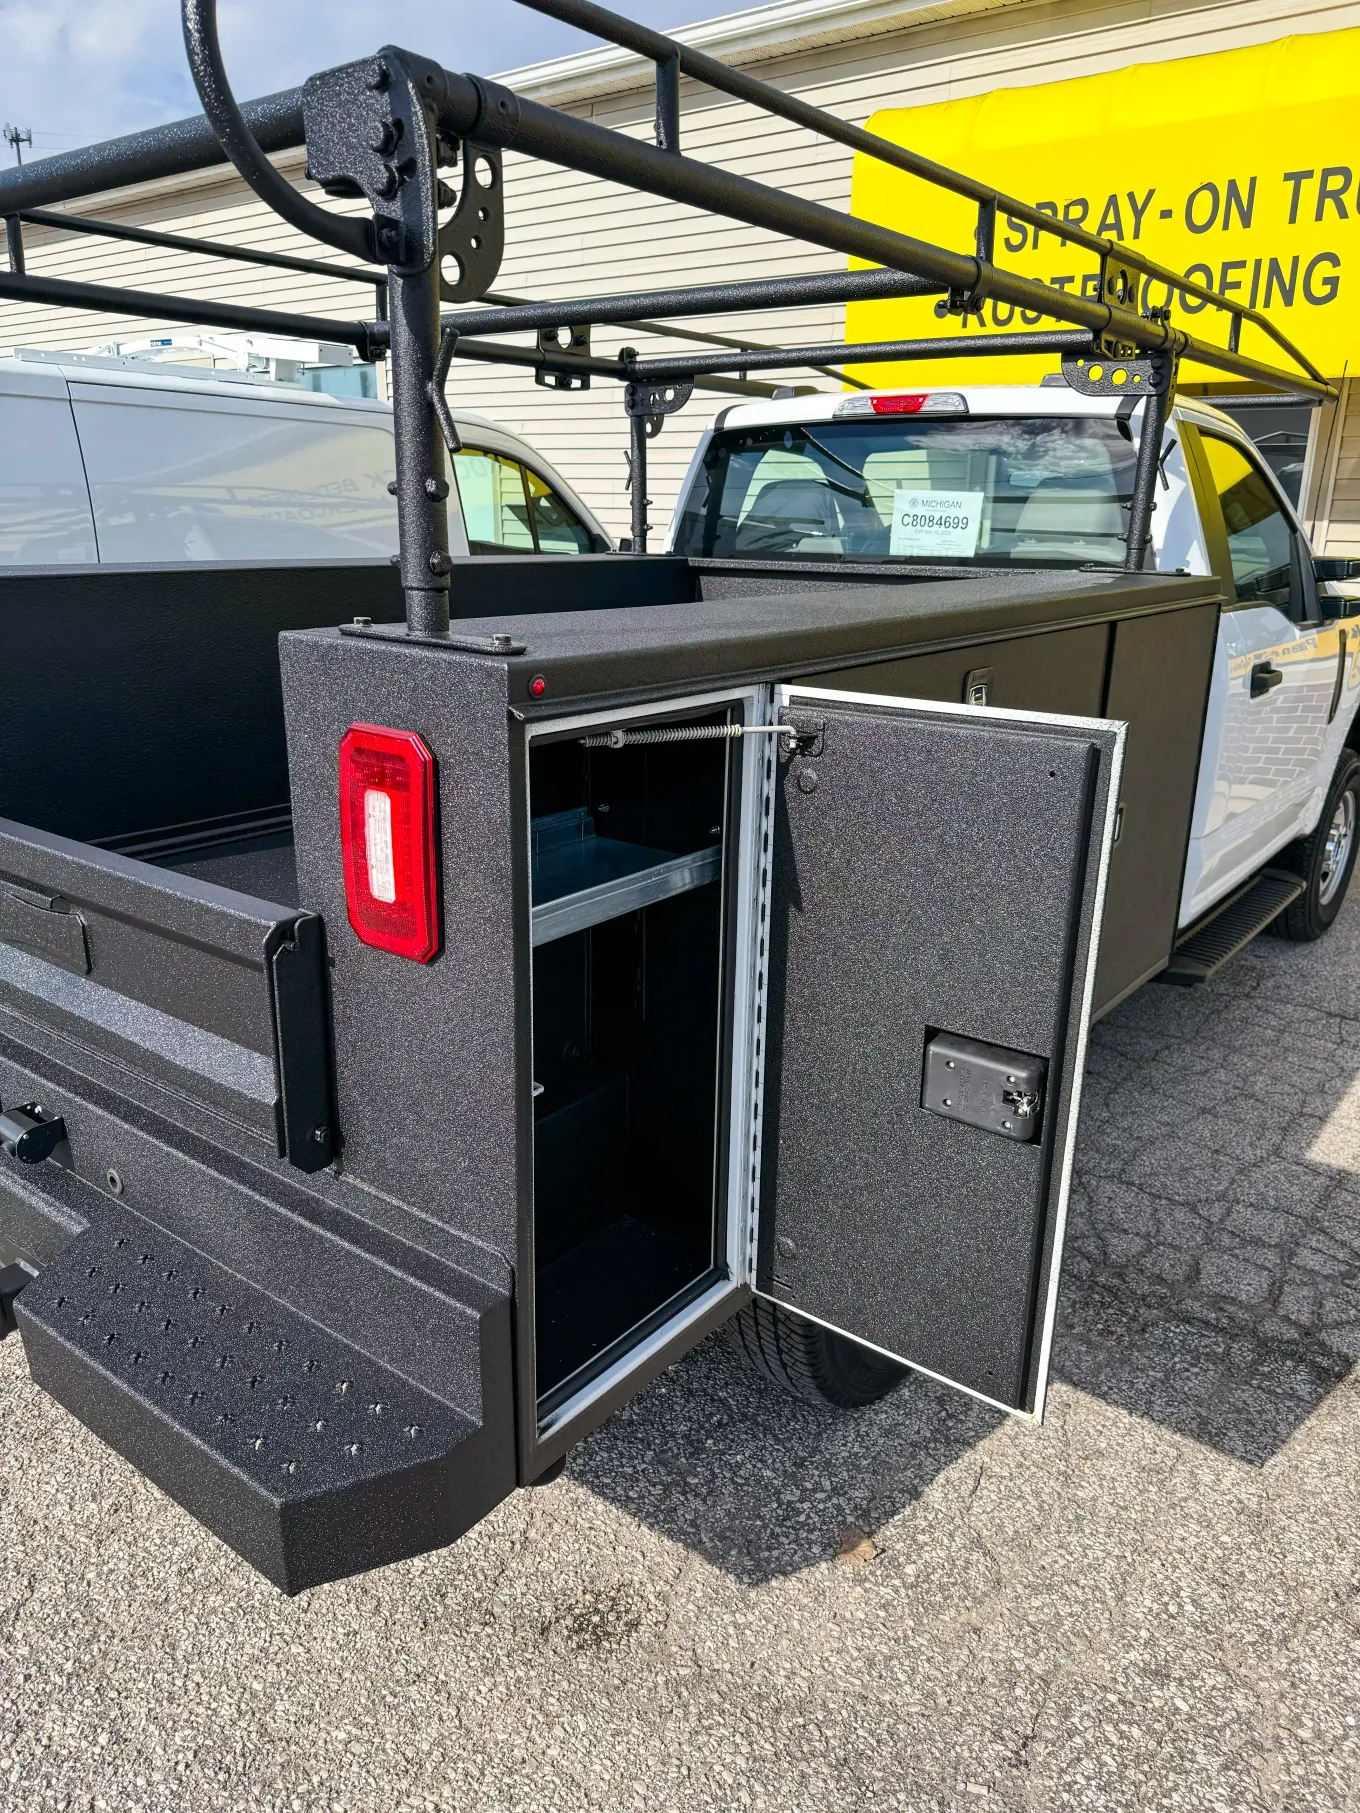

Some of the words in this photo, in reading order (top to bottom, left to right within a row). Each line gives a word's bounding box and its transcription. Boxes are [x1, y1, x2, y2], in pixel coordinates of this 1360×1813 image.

[1004, 175, 1257, 253] SPRAY-ON
[1283, 165, 1360, 225] TR
[921, 499, 962, 509] MICHIGAN
[901, 513, 969, 530] C8084699
